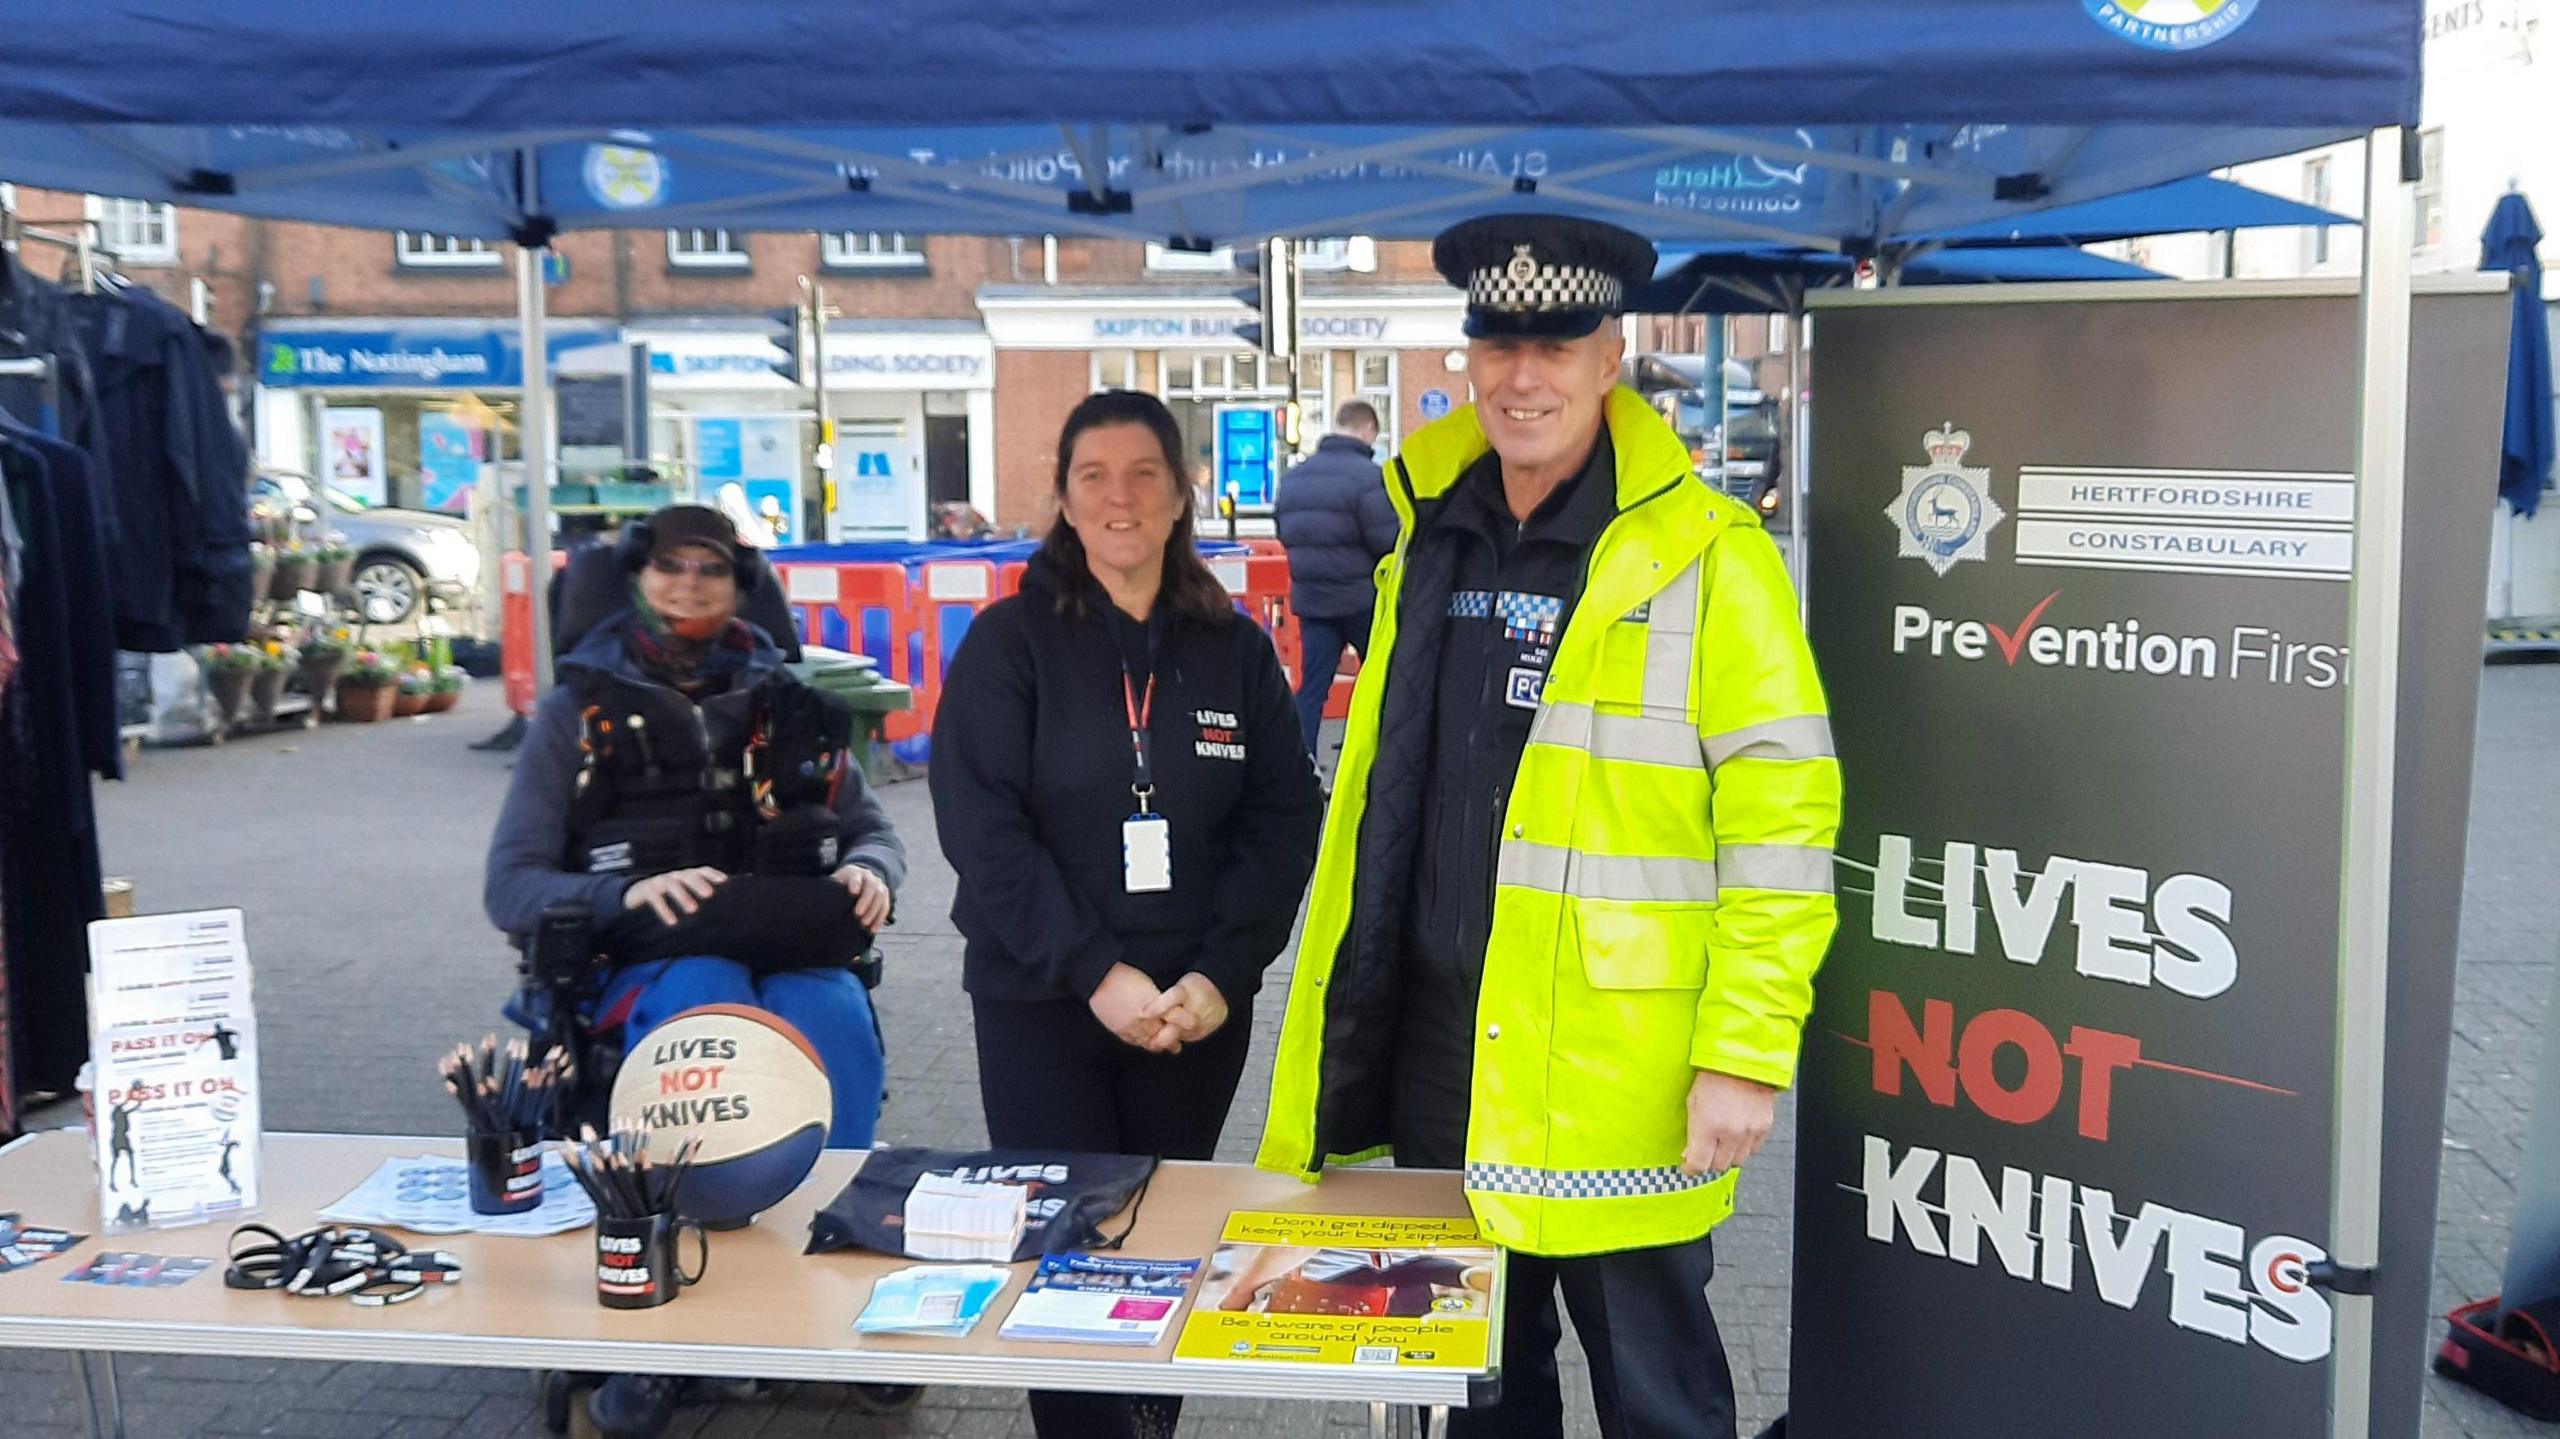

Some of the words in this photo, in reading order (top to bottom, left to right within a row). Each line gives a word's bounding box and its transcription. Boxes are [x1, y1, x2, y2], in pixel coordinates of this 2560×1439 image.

[2098, 1, 2241, 43] PARTNERSHIP
[1093, 318, 1184, 338] SKIPTON
[300, 346, 345, 373] The
[893, 353, 984, 376] SOCIETY
[2070, 484, 2314, 510] HERTFORDSHIRE
[2067, 530, 2309, 558] CONSTABULARY
[1195, 709, 1239, 728] LIVES
[1202, 727, 1233, 742] NOT
[1194, 740, 1246, 760] KNIVES
[1872, 834, 2240, 1000] LIVES
[653, 1037, 738, 1067] LIVES
[1867, 989, 2142, 1142] NOT
[659, 1065, 728, 1096] NOT
[641, 1094, 750, 1129] KNIVES
[952, 1164, 1070, 1185] LIVES
[1241, 1225, 1296, 1237] keep
[1300, 1229, 1347, 1239] your
[1355, 1230, 1398, 1242] bag
[1272, 1216, 1325, 1227] Don't
[1330, 1219, 1366, 1231] get
[1862, 1133, 2335, 1364] KNIVES
[1220, 1316, 1250, 1327] Be
[1256, 1320, 1335, 1331] aware
[1340, 1321, 1366, 1332] of
[1371, 1322, 1455, 1335] people
[1269, 1331, 1357, 1343] around
[1362, 1335, 1408, 1345] you
